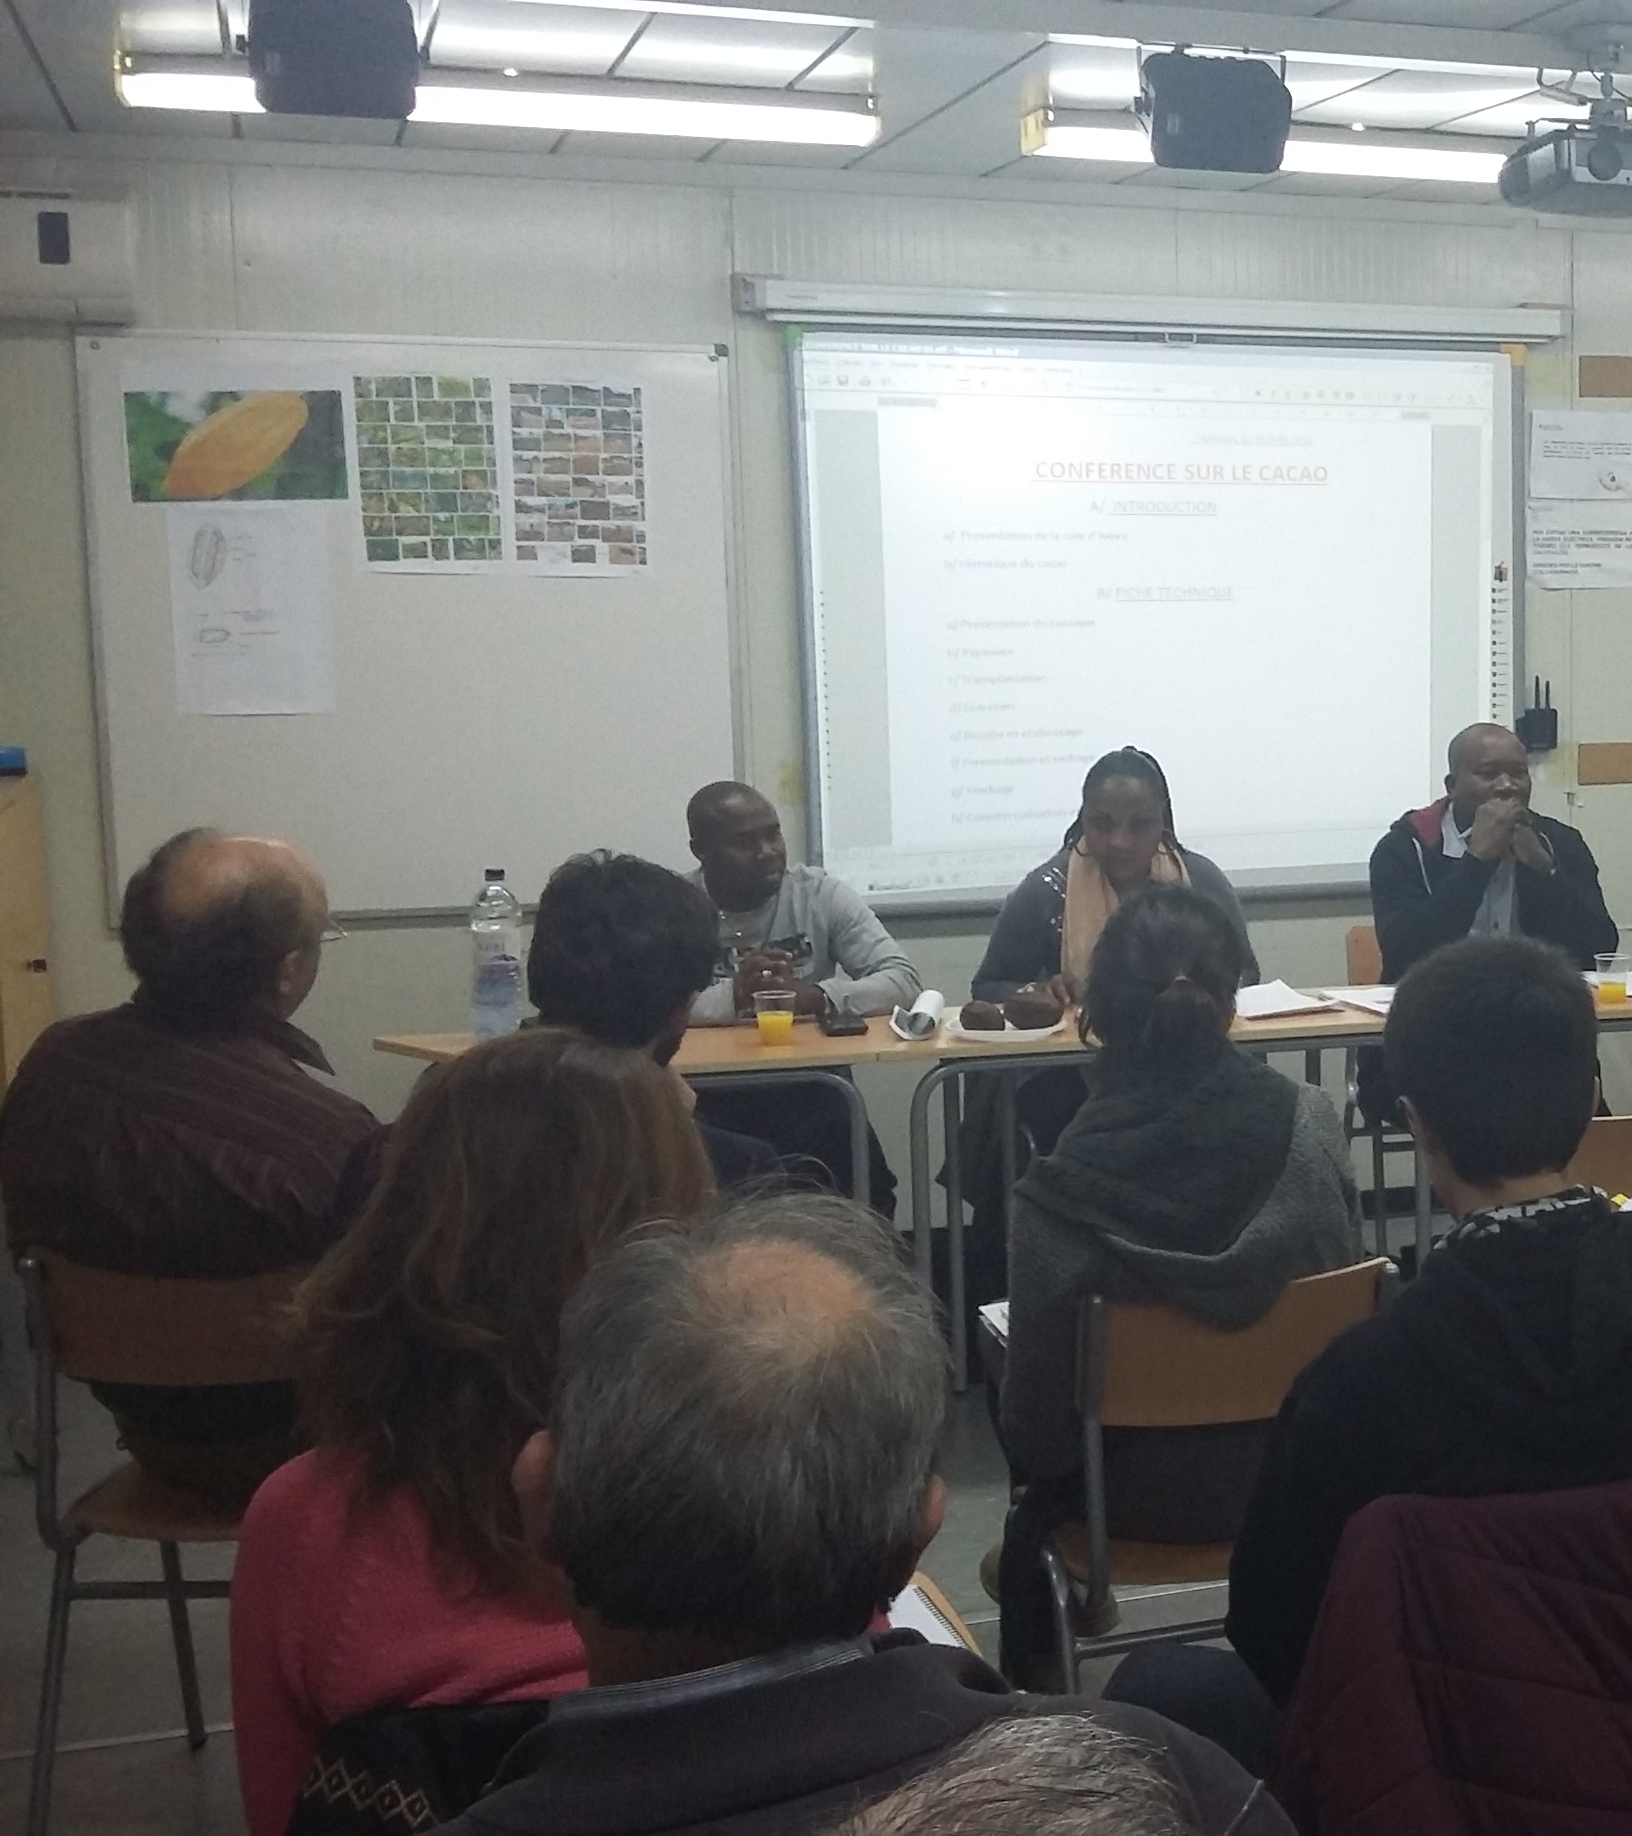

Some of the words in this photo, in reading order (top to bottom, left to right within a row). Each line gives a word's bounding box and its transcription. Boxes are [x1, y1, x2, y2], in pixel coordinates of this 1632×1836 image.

[1035, 461, 1178, 481] CONFERENCE
[1184, 463, 1225, 481] SUR
[1231, 464, 1252, 482] LE
[1258, 465, 1329, 483] CACAO
[1113, 501, 1217, 514] INTRODUCTION
[1116, 586, 1152, 599] FICHE
[1158, 586, 1233, 599] TECHNIQUE
